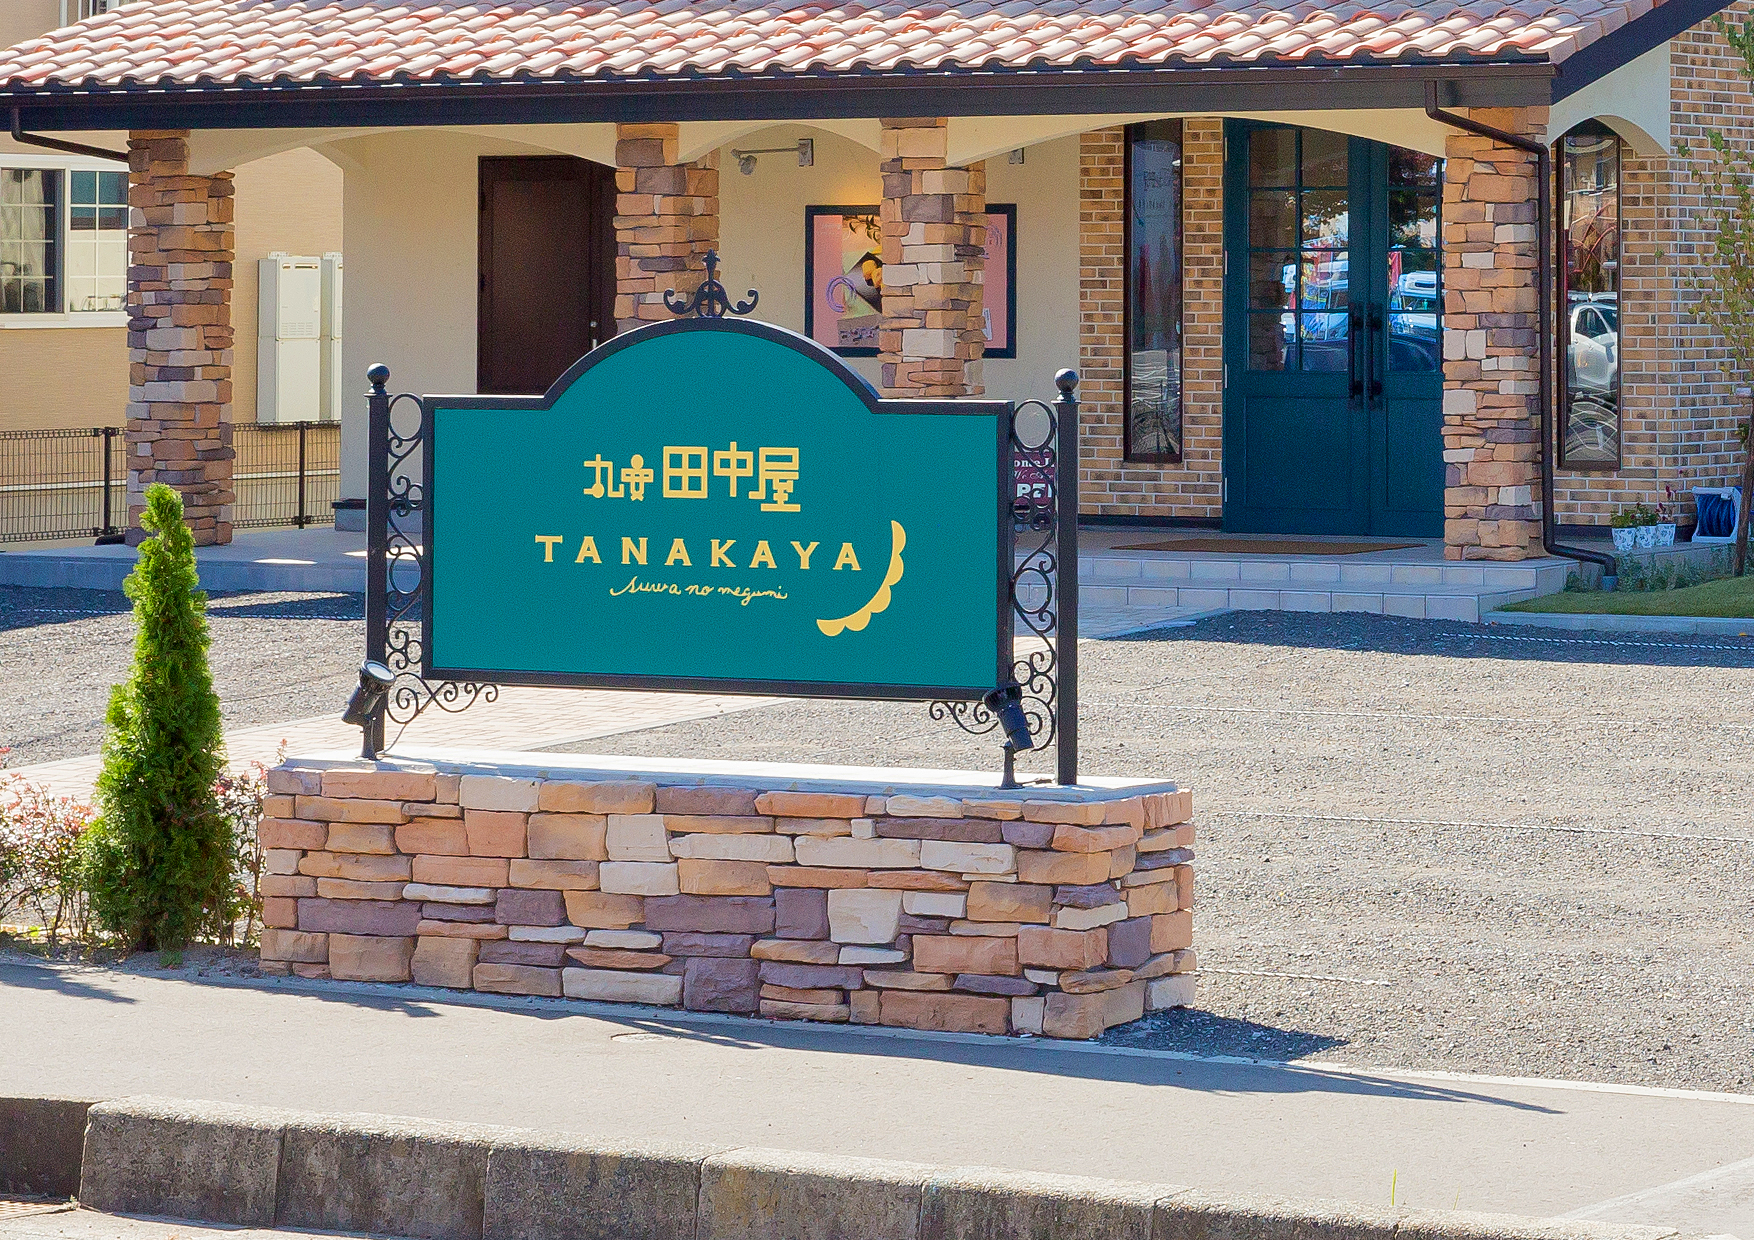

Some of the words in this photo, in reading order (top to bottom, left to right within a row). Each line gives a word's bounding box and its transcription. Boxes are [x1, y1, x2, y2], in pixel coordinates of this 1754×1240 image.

[535, 534, 862, 571] TANAKAYA
[685, 584, 714, 596] no
[717, 585, 788, 606] megumi
